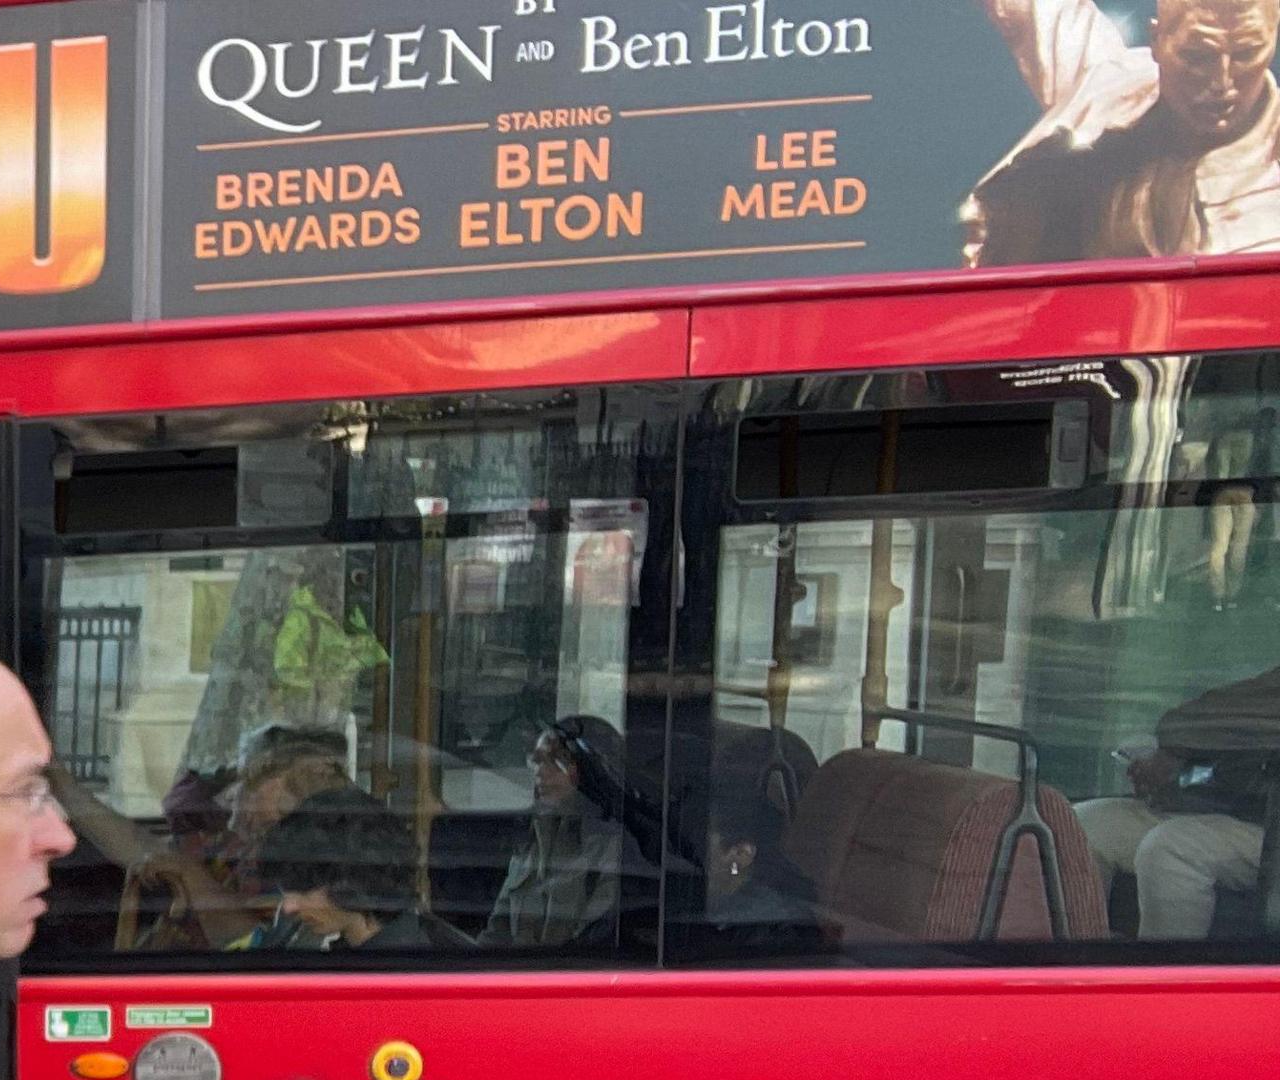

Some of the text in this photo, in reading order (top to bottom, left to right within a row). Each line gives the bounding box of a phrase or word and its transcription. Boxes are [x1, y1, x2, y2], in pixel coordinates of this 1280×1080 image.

[197, 0, 872, 134] QUEEN AND Ben Elton
[497, 105, 612, 134] STARRING
[496, 137, 610, 189] BEN
[755, 129, 838, 171] LEE
[215, 162, 403, 211] BRENDA
[720, 177, 868, 222] MEAD
[194, 207, 421, 259] EDWARDS
[459, 191, 644, 248] ELTON
